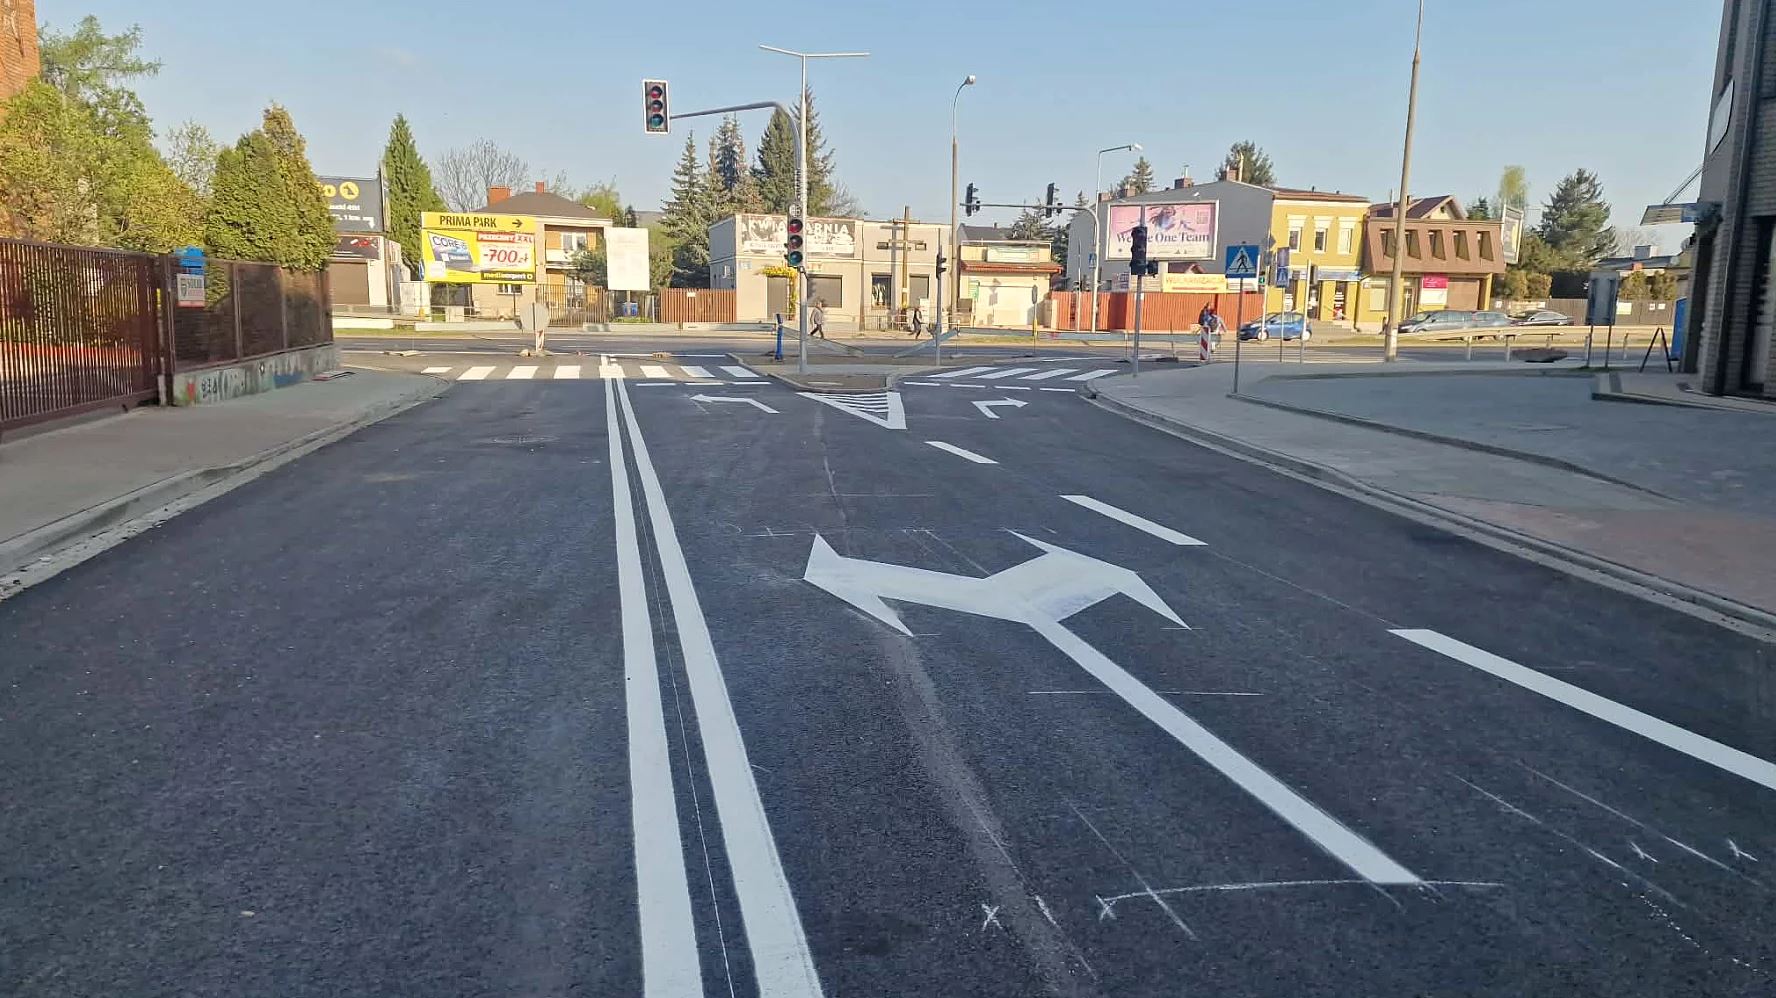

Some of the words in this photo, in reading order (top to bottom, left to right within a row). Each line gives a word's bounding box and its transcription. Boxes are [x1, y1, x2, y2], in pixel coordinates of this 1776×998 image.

[440, 215, 471, 227] PRIMA
[474, 217, 497, 228] PARK
[750, 218, 850, 235] KWIAARNIA
[1155, 231, 1178, 243] One
[1179, 231, 1210, 243] Team
[483, 249, 518, 263] -700
